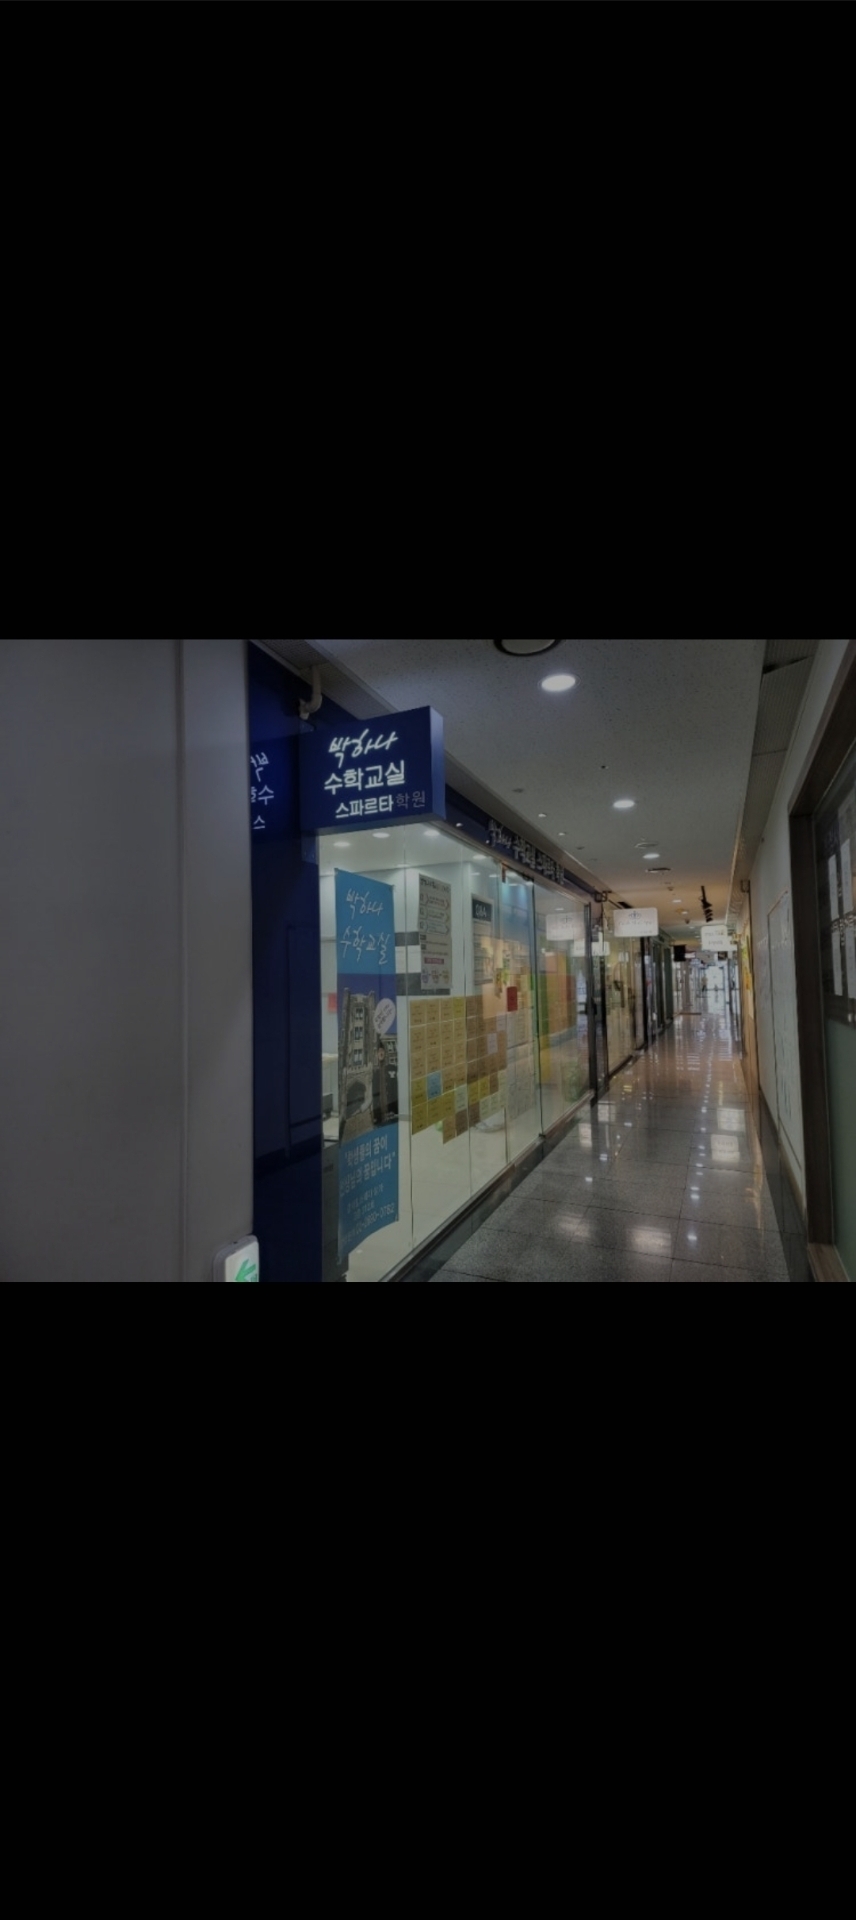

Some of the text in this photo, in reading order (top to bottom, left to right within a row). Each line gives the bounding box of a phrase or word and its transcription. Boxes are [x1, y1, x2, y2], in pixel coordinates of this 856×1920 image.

[328, 728, 398, 769] 박하나
[323, 759, 405, 795] 수학교실
[335, 794, 394, 819] 스파르타
[345, 888, 384, 920] 박하나
[340, 926, 391, 966] 수학교실
[373, 1134, 388, 1156] 꿈이
